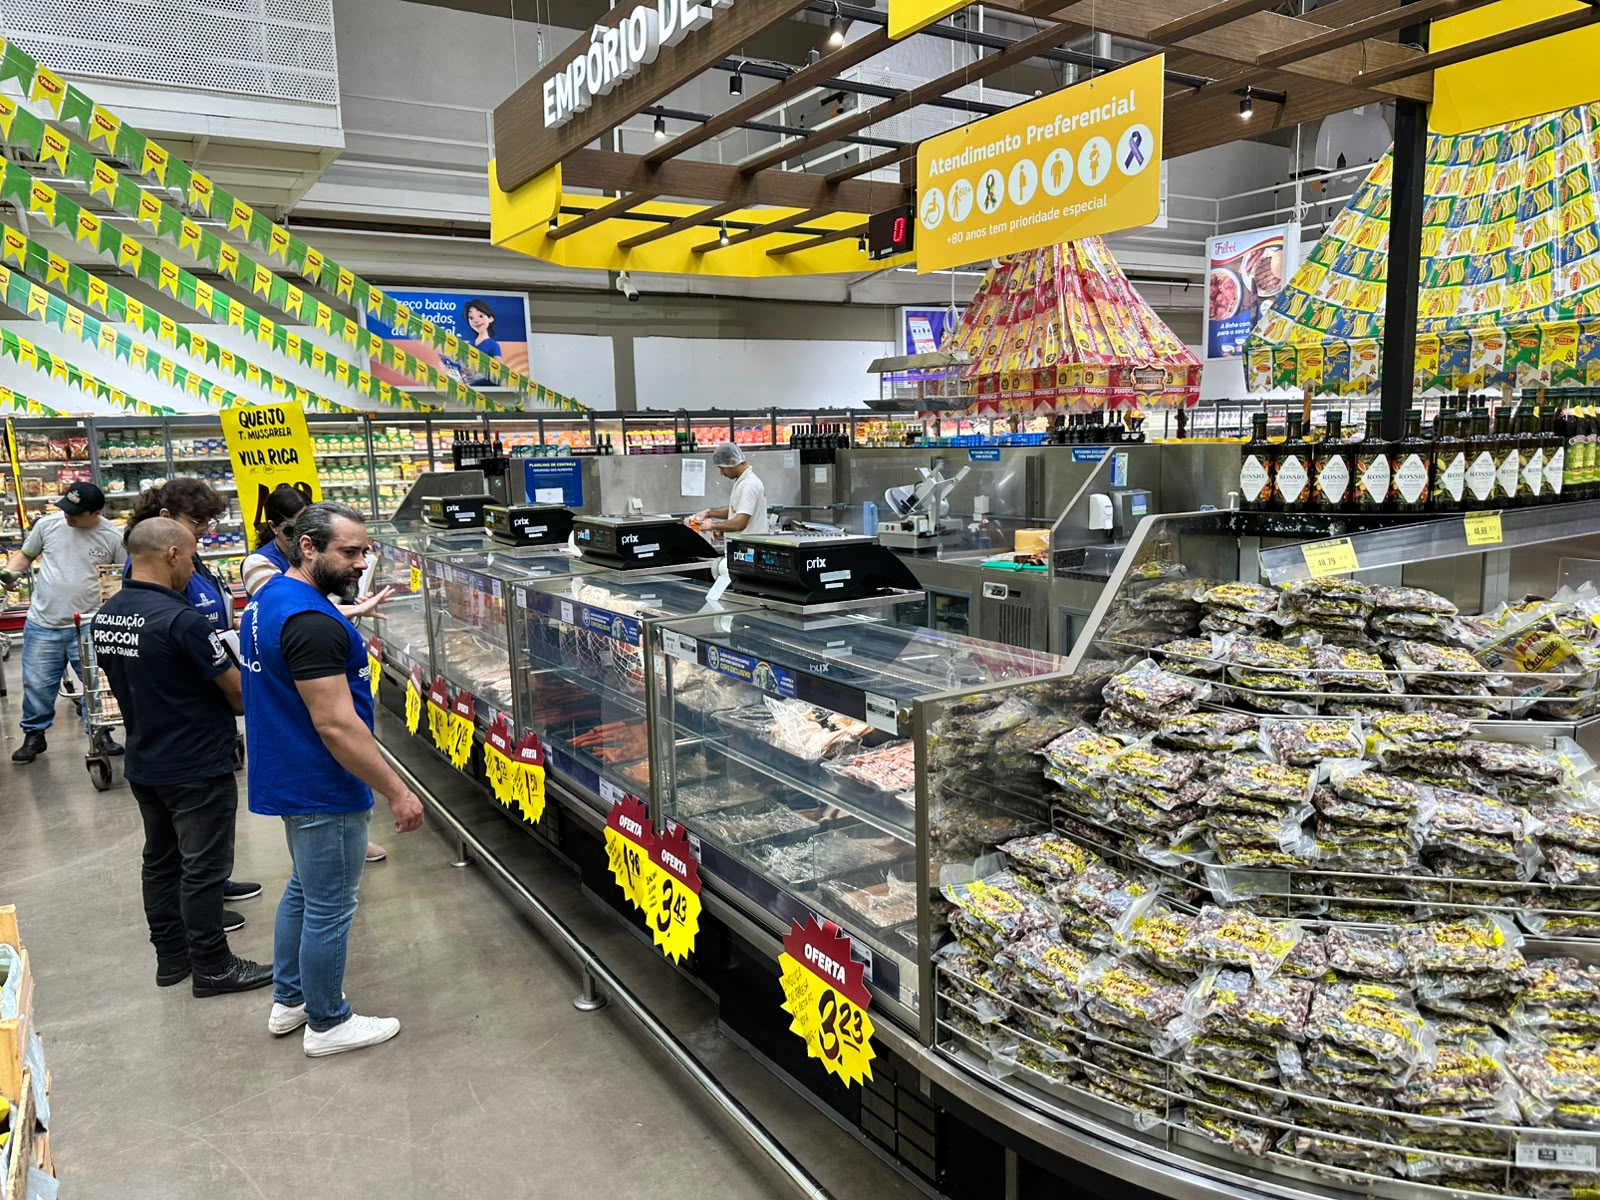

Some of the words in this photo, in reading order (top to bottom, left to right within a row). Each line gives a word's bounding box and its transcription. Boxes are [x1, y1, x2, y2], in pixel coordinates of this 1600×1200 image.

[543, 4, 655, 129] EMPÓRIO
[929, 131, 1021, 178] Atendimento
[1026, 89, 1136, 146] Preferencial
[946, 231, 963, 245] +80
[965, 226, 987, 242] anos
[988, 220, 1007, 236] tem
[1009, 205, 1060, 233] prioridade
[1062, 194, 1108, 218] especial
[892, 216, 906, 243] 0
[425, 298, 457, 311] baixo
[421, 312, 456, 325] todos,
[1226, 321, 1239, 329] linha
[1217, 330, 1229, 338] para
[238, 407, 286, 430] QUEIJO
[247, 426, 292, 441] MUSSARELA
[237, 449, 267, 467] VILA
[267, 447, 300, 466] RICA
[514, 517, 530, 527] prix
[621, 533, 639, 545] prix
[733, 549, 745, 562] prix
[806, 556, 827, 572] prix
[94, 613, 146, 631] FISCALIZAÇÃO
[93, 629, 140, 647] PROCON
[94, 644, 117, 654] CAMPO
[116, 646, 141, 658] GRANDE
[1522, 640, 1561, 672] Charque
[618, 814, 643, 838] OFERTA
[660, 848, 687, 878] OFERTA
[804, 942, 846, 985] OFERTA
